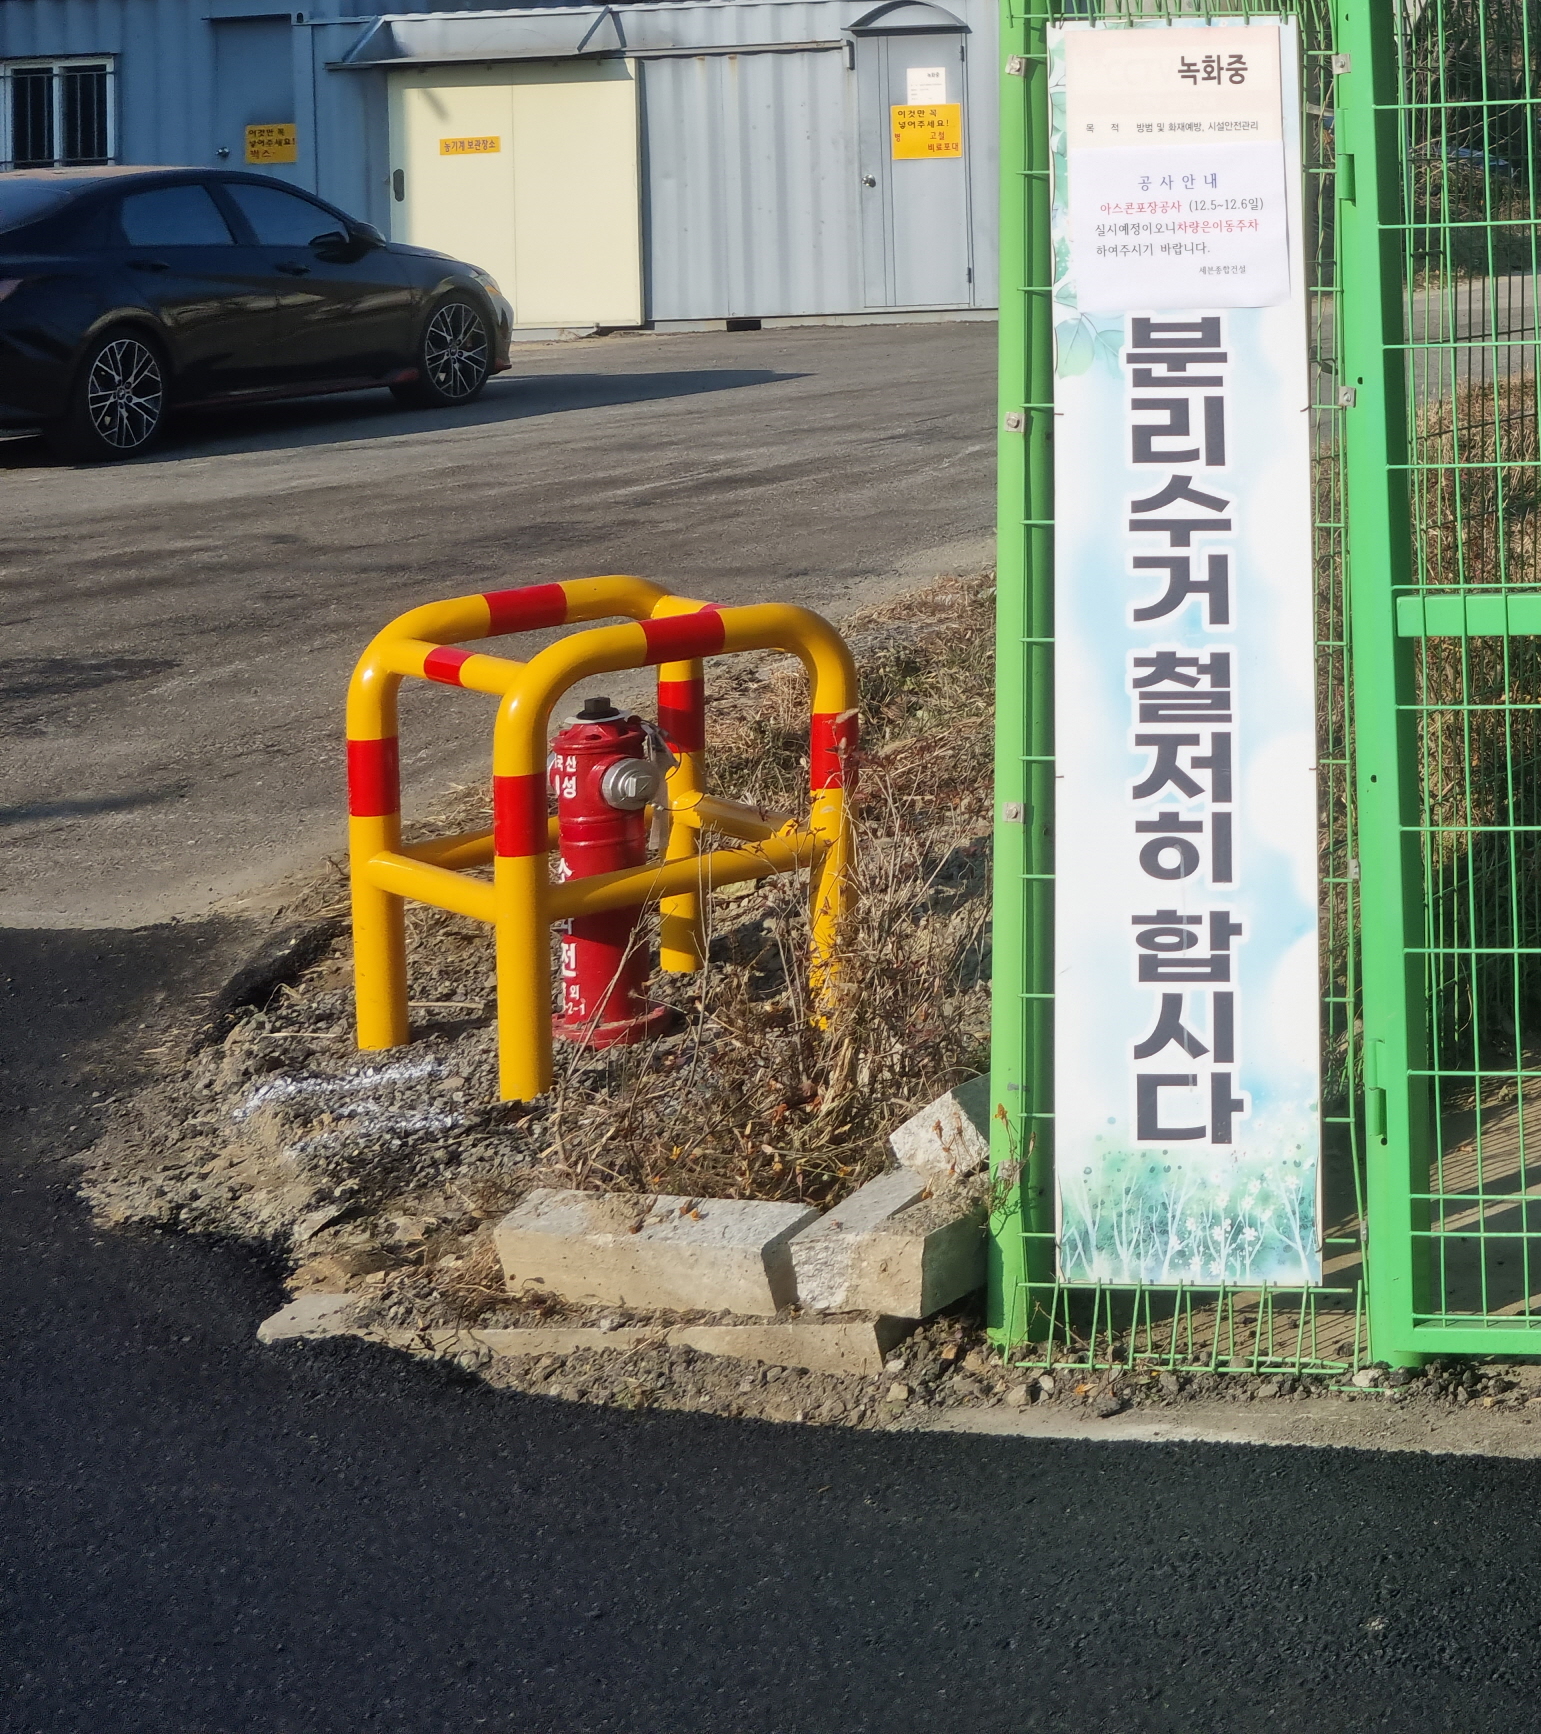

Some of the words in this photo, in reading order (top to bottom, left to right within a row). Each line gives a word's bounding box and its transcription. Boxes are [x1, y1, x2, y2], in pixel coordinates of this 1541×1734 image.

[1178, 54, 1249, 85] 녹화중
[898, 110, 925, 118] 이것만
[898, 119, 949, 129] 넣어주세요!
[1086, 123, 1095, 133] 목
[1111, 123, 1120, 132] 적
[1136, 123, 1153, 133] 방범
[1156, 123, 1165, 132] 및
[1168, 122, 1204, 133] 화재예방,
[1208, 121, 1259, 132] 시설안전관리
[444, 140, 465, 153] 농기계
[467, 139, 496, 151] 보관장소
[1100, 200, 1182, 215] 아스콘포장공사
[1189, 197, 1264, 213] (12.5~12.6일)
[1096, 243, 1153, 257] 하여주시기
[1160, 242, 1211, 256] 바랍니다.
[1125, 316, 1232, 626] 분리수거
[1132, 650, 1233, 884] 철저히
[1131, 909, 1244, 1145] 합시다
